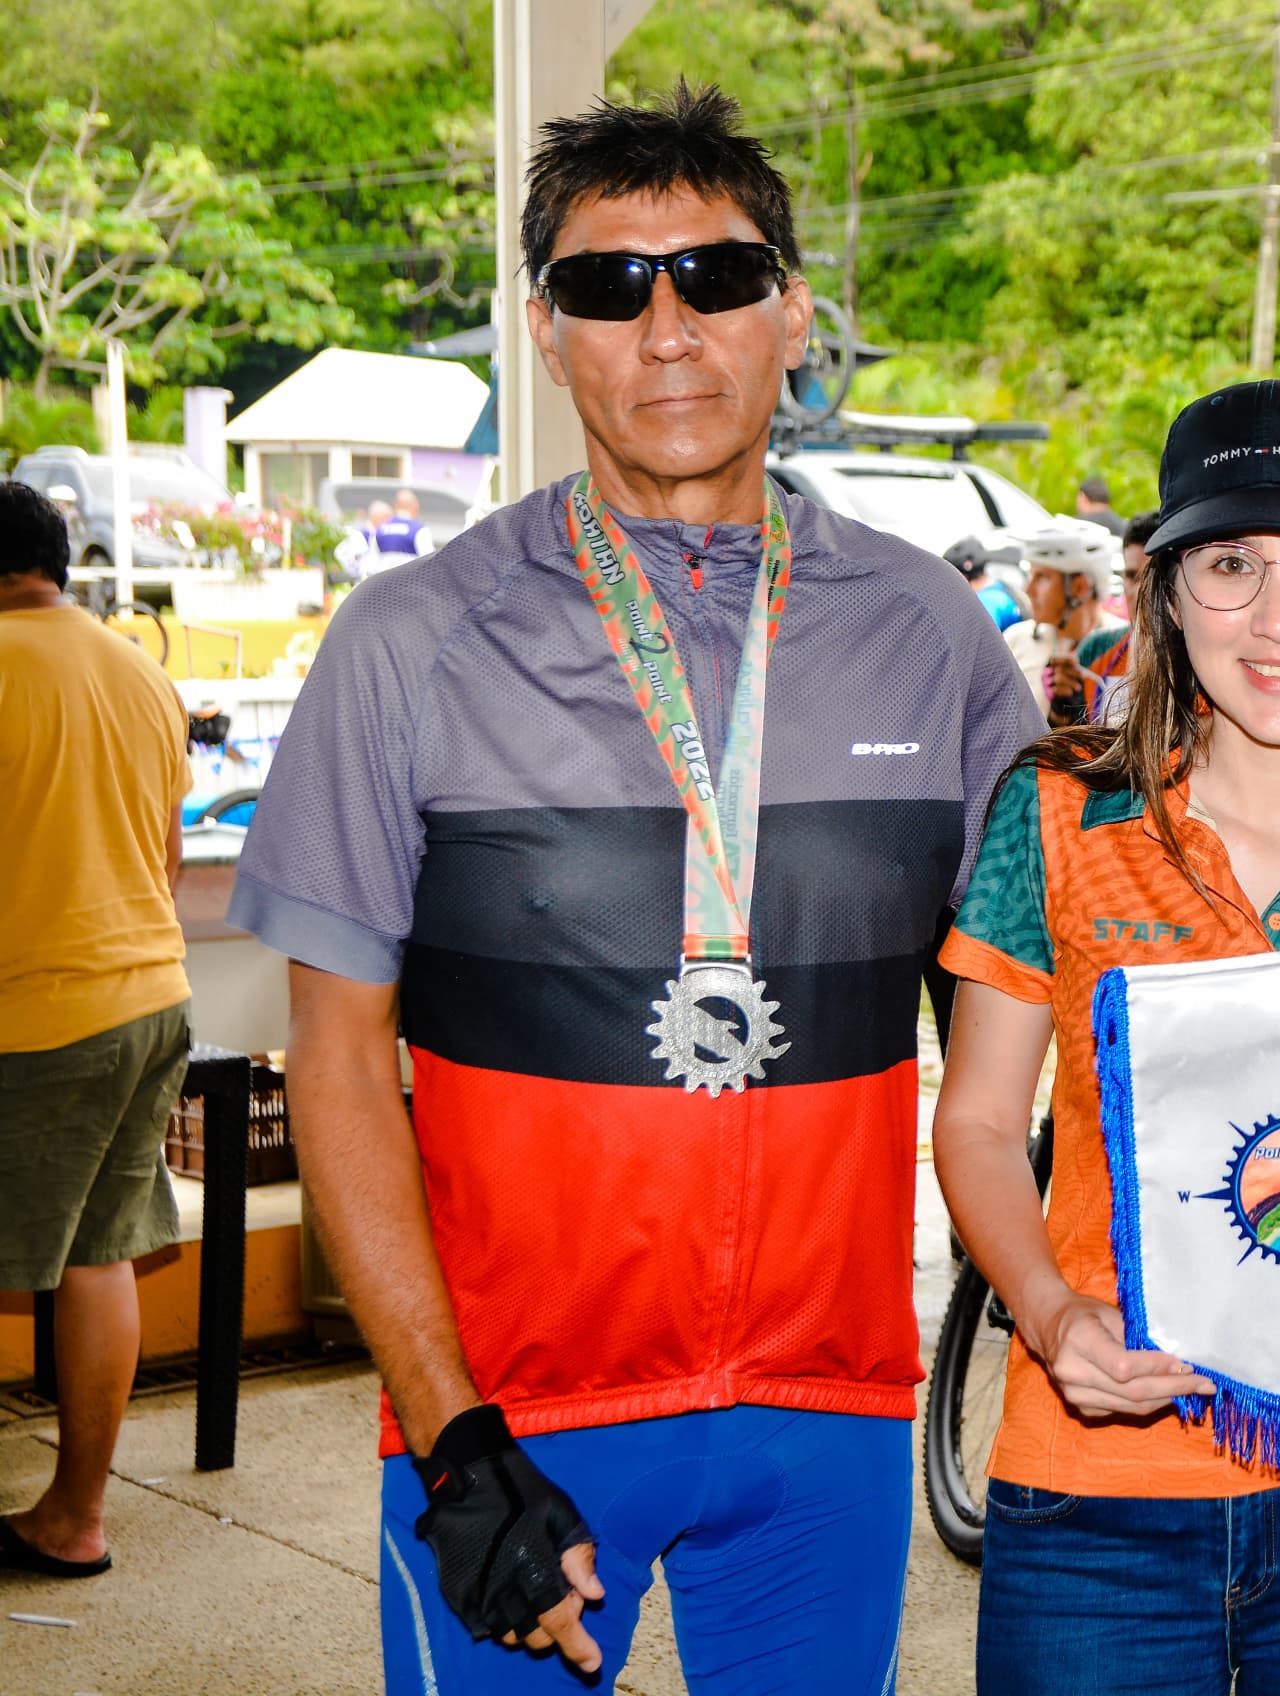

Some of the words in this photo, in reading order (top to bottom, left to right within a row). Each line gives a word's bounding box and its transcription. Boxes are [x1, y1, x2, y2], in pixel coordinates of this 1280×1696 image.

[1203, 447, 1251, 468] TOMMY
[629, 632, 670, 665] 2
[671, 719, 716, 801] 2022
[1093, 918, 1194, 944] STAFF
[1177, 1190, 1191, 1203] W
